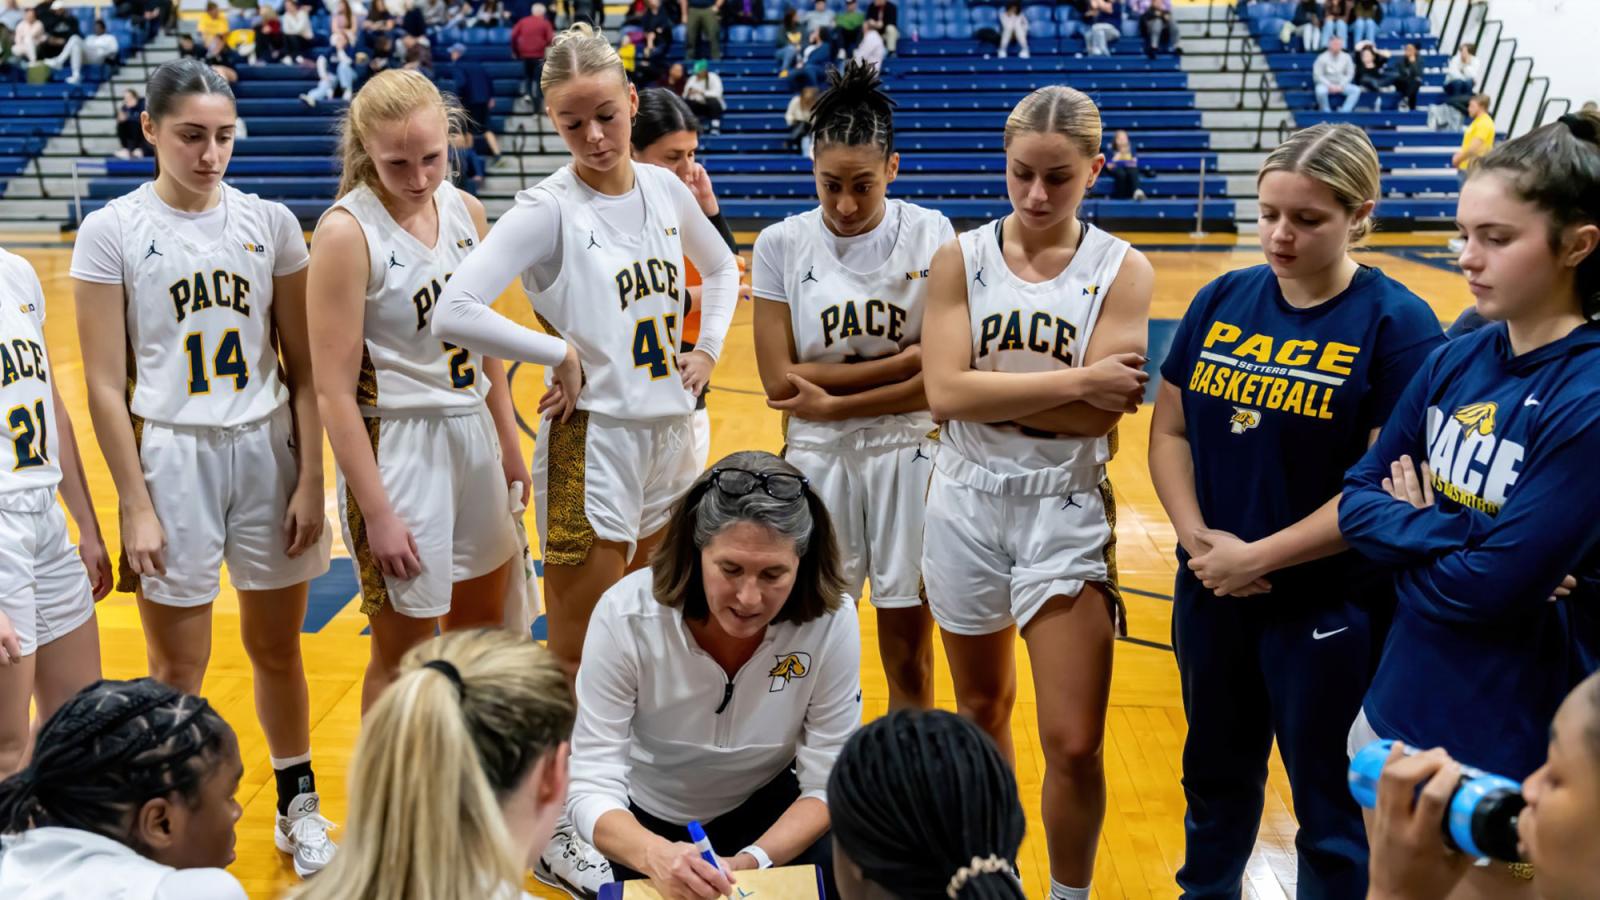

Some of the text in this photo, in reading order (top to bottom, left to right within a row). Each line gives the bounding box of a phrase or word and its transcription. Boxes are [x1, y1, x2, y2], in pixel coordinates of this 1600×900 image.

[169, 269, 250, 323] PACE
[615, 258, 680, 312] PACE
[820, 298, 907, 348] PACE
[977, 309, 1077, 366] PACE
[1203, 320, 1361, 376] PACE
[1, 338, 48, 388] ACE
[183, 327, 250, 395] 14
[1238, 360, 1288, 375] SETTERS
[1189, 360, 1334, 420] BASKETBALL
[6, 397, 51, 473] 21
